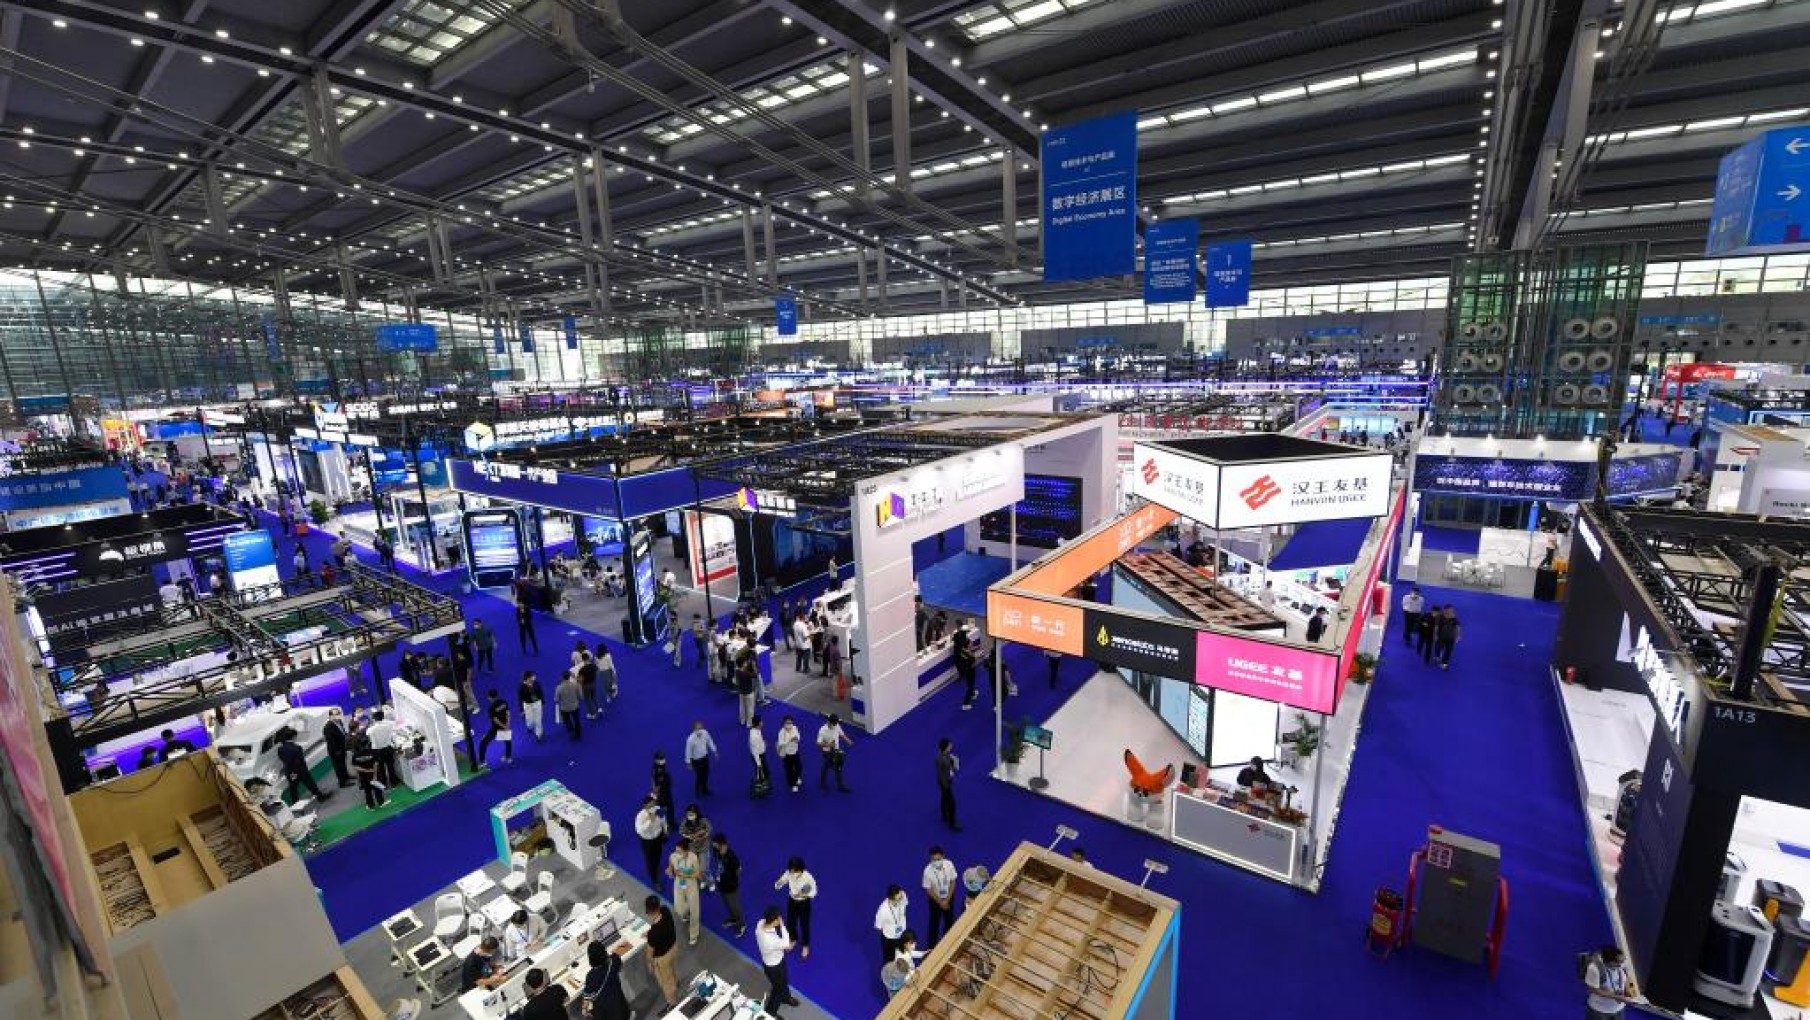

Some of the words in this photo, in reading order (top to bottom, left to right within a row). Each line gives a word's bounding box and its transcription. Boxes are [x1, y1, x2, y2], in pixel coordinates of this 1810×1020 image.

[1052, 186, 1126, 210] 数字经济展区
[1052, 217, 1072, 226] Digital
[1074, 212, 1106, 221] Economy
[1164, 472, 1204, 495] 汉王友基
[1293, 478, 1368, 494] 汉王友基
[1292, 496, 1336, 507] HANVON
[1338, 494, 1367, 503] UGEE
[1228, 656, 1268, 674] UGEE
[1271, 665, 1303, 680] 友基
[1714, 705, 1757, 724] 1A13
